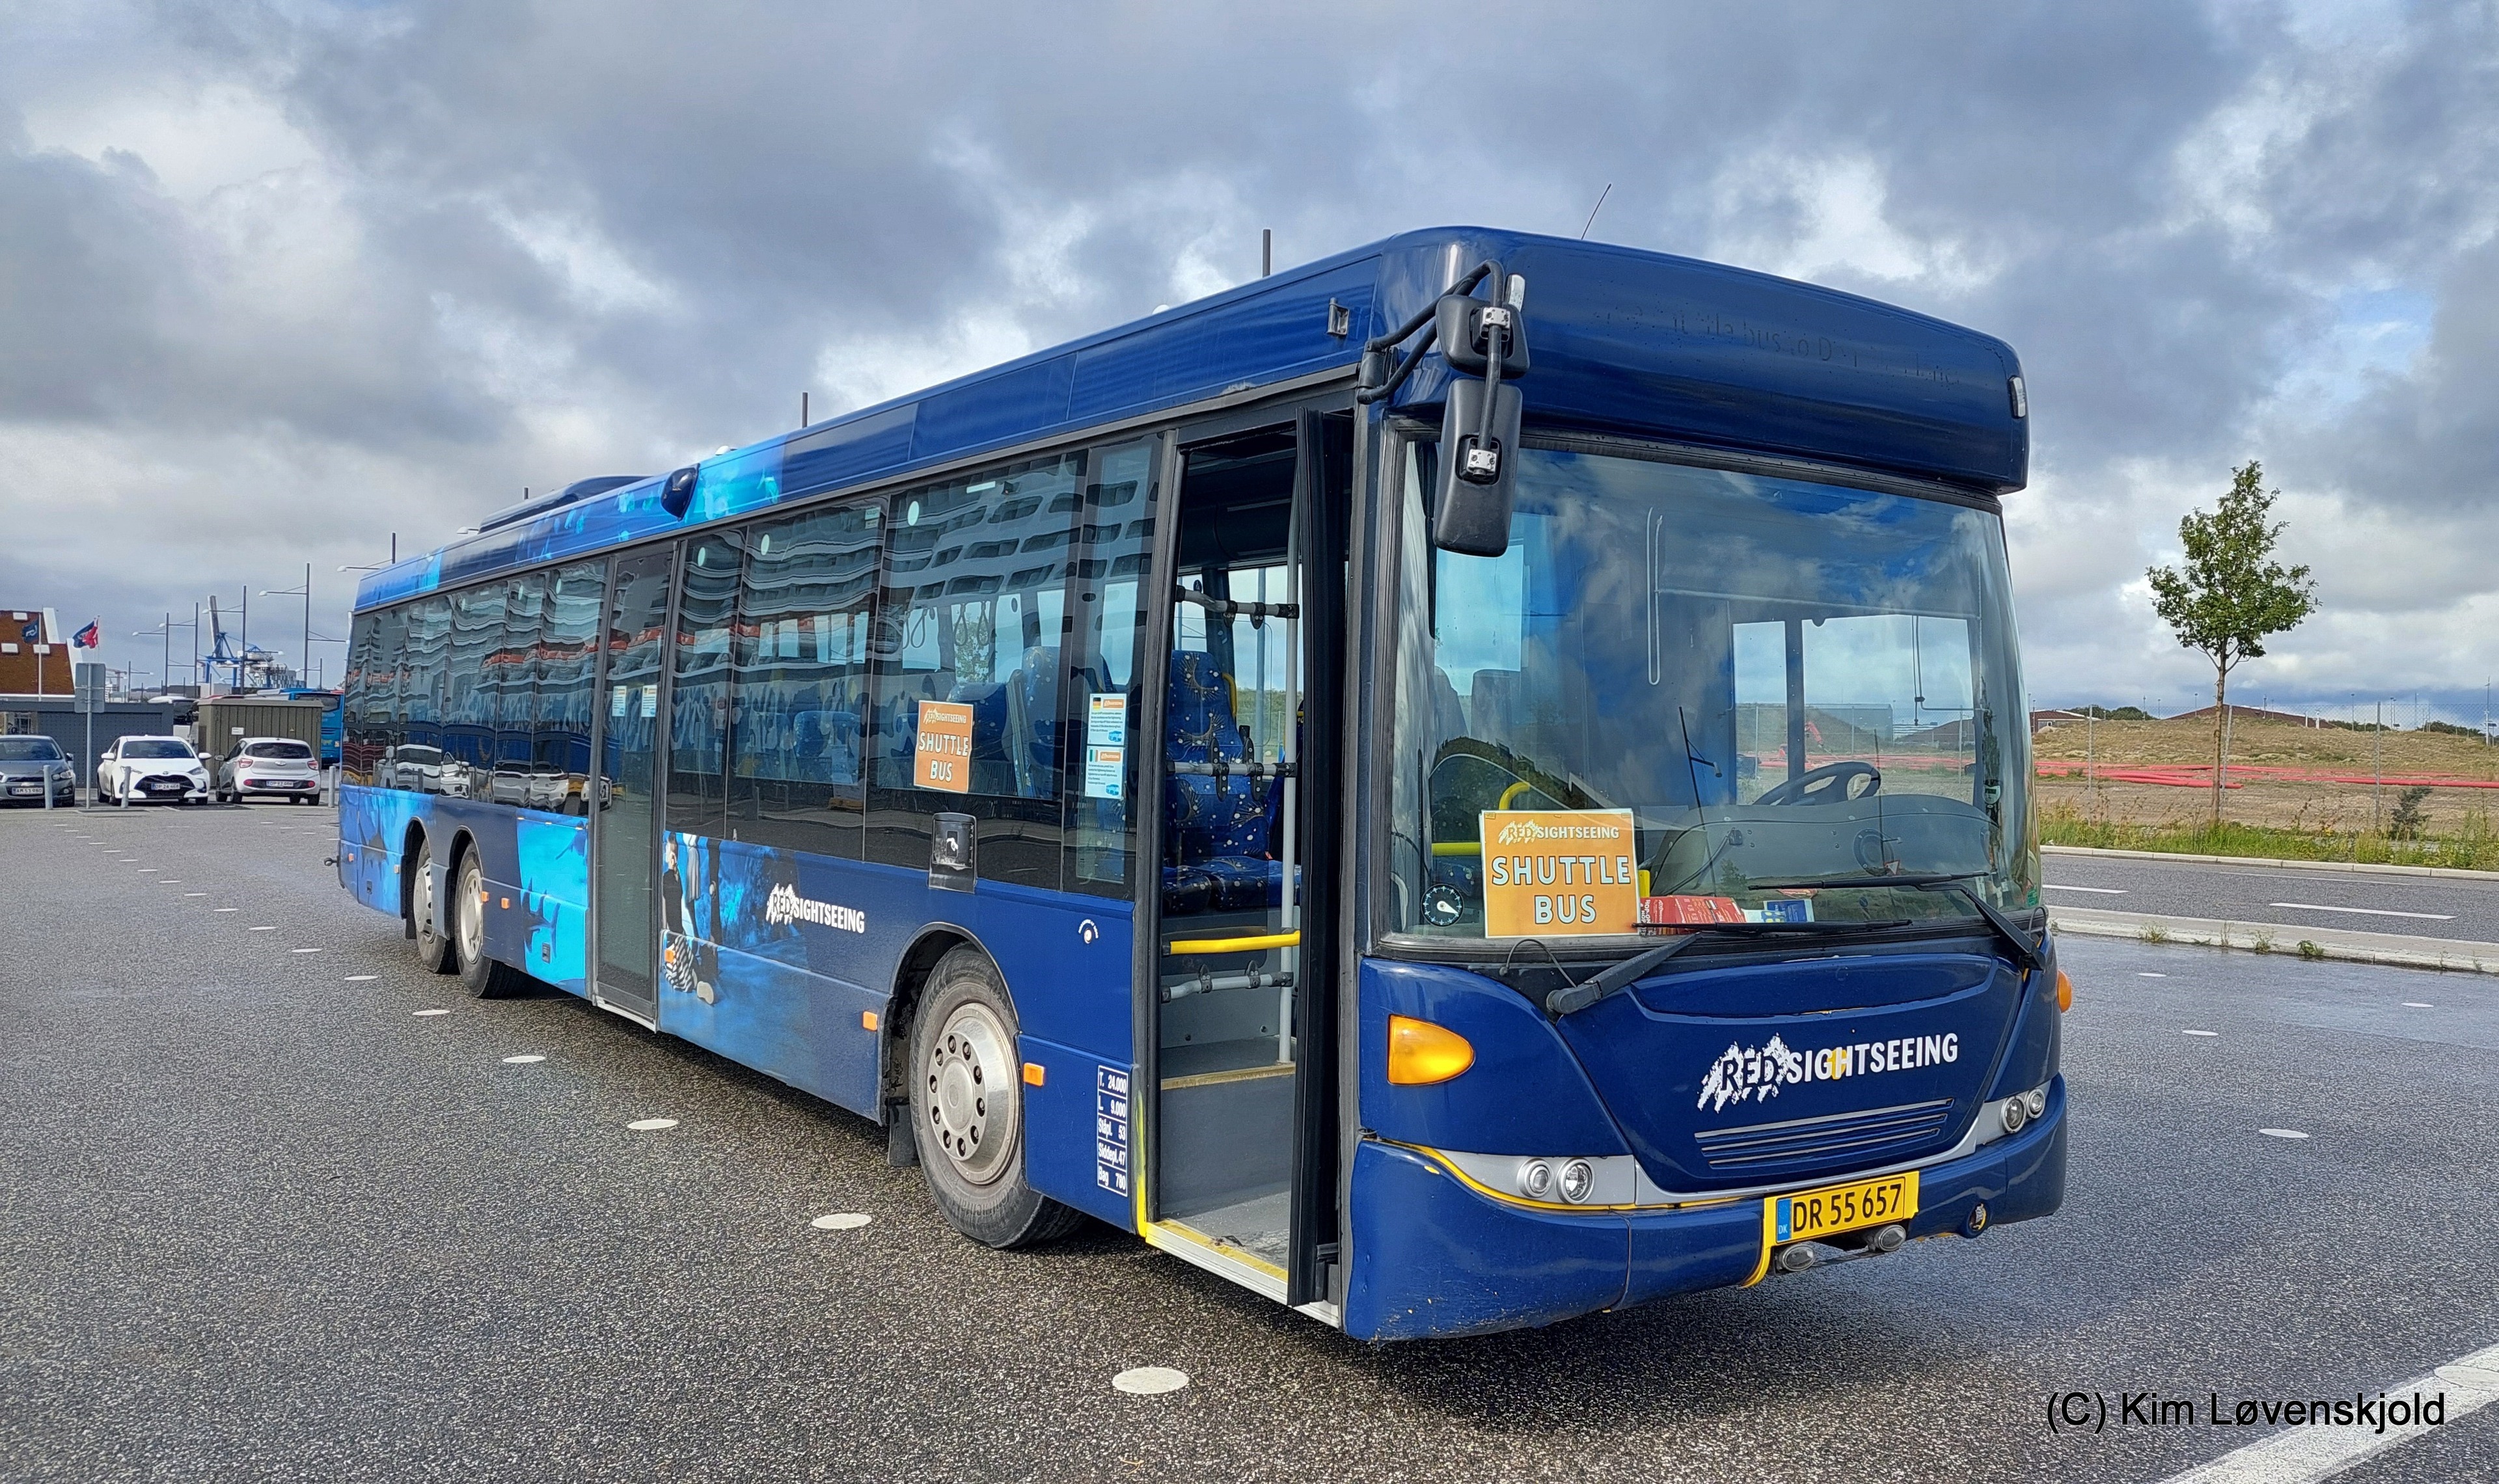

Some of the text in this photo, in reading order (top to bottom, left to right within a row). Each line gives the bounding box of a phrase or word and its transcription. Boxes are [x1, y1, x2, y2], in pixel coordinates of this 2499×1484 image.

[918, 731, 968, 757] SHUTTLE
[930, 759, 953, 782] BUS
[1492, 856, 1631, 885] SHUTTLE
[1535, 894, 1596, 924] BUS
[1099, 1072, 1127, 1094] T. 24.000
[1110, 1100, 1126, 1118] 9.000
[1118, 1125, 1126, 1140] 53
[1099, 1142, 1126, 1166] Siddepl. 47
[1099, 1166, 1126, 1191] Bag 780
[1793, 1183, 1902, 1232] DR 55 657
[1778, 1224, 1788, 1235] DK
